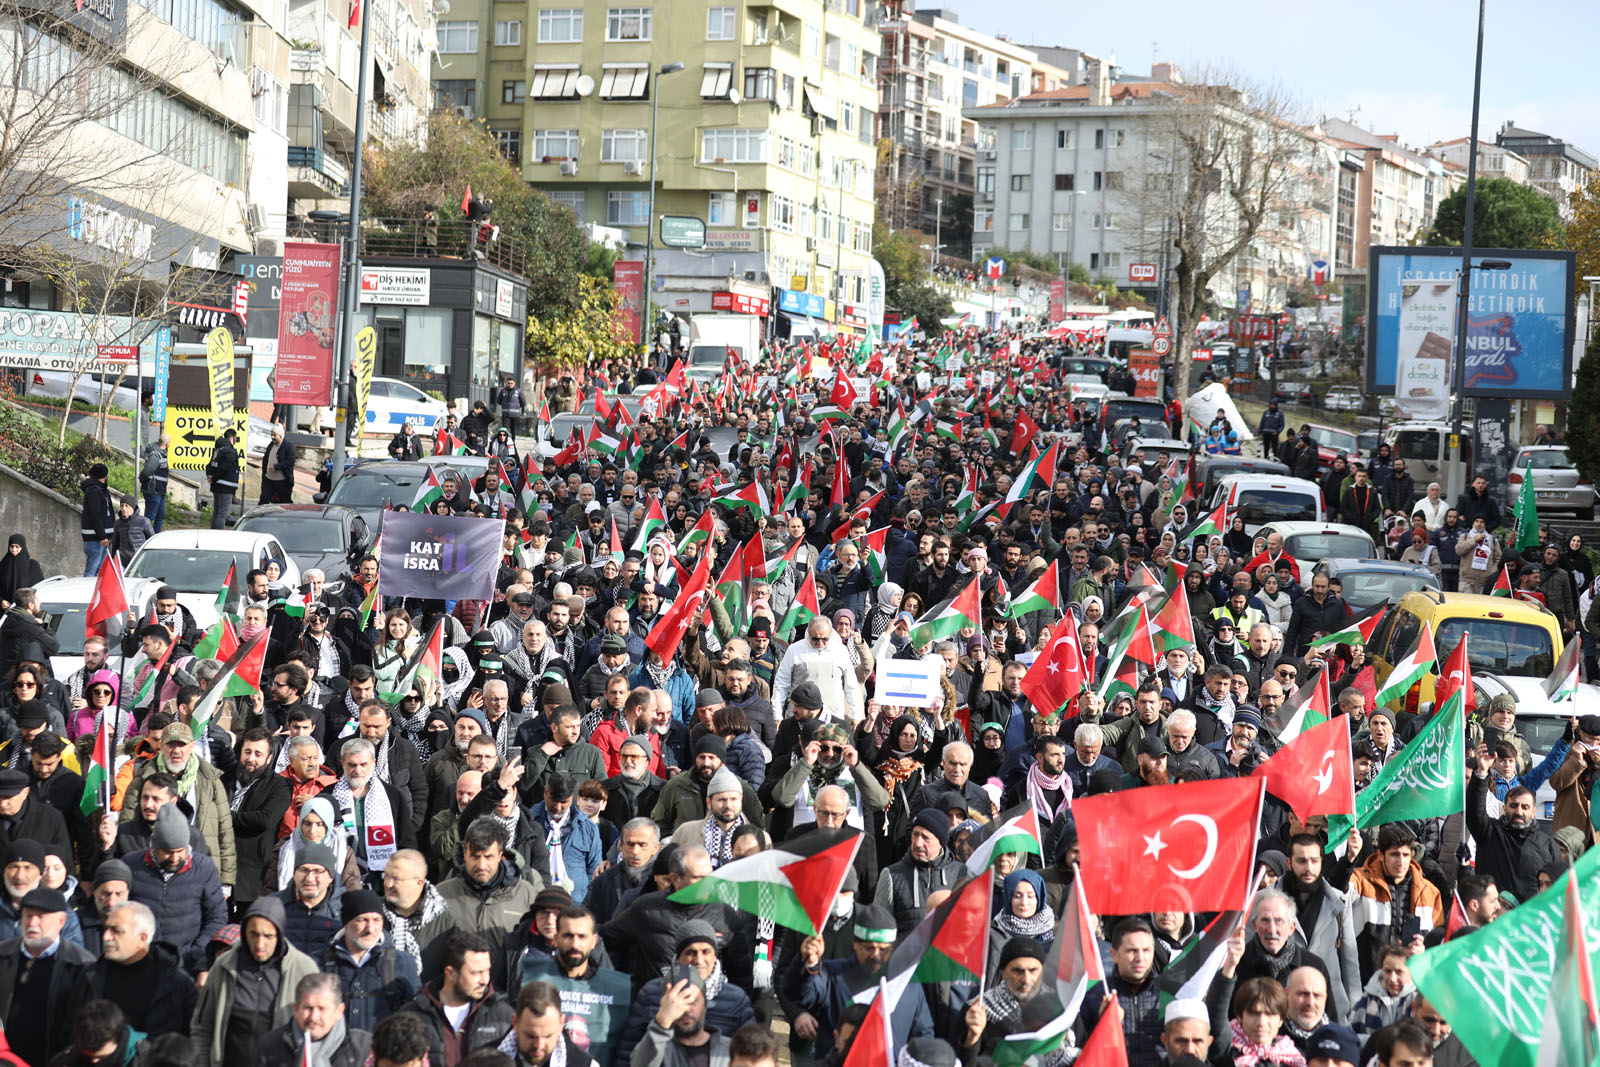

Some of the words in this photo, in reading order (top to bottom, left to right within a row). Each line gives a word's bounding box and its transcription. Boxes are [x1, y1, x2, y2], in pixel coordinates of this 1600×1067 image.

[379, 274, 393, 285] DİŞ
[395, 274, 427, 285] HEKİMİ
[1468, 292, 1546, 313] GETİRDİK
[179, 307, 226, 327] GARAGE
[27, 341, 64, 353] KAYDI
[1155, 340, 1167, 350] 30
[51, 359, 74, 369] OTO
[1408, 365, 1439, 379] damak
[176, 417, 246, 431] OTOPK
[405, 415, 425, 426] POLİS
[174, 446, 245, 459] OTOYIA
[410, 541, 441, 554] KAT
[559, 990, 582, 1001] ADECE
